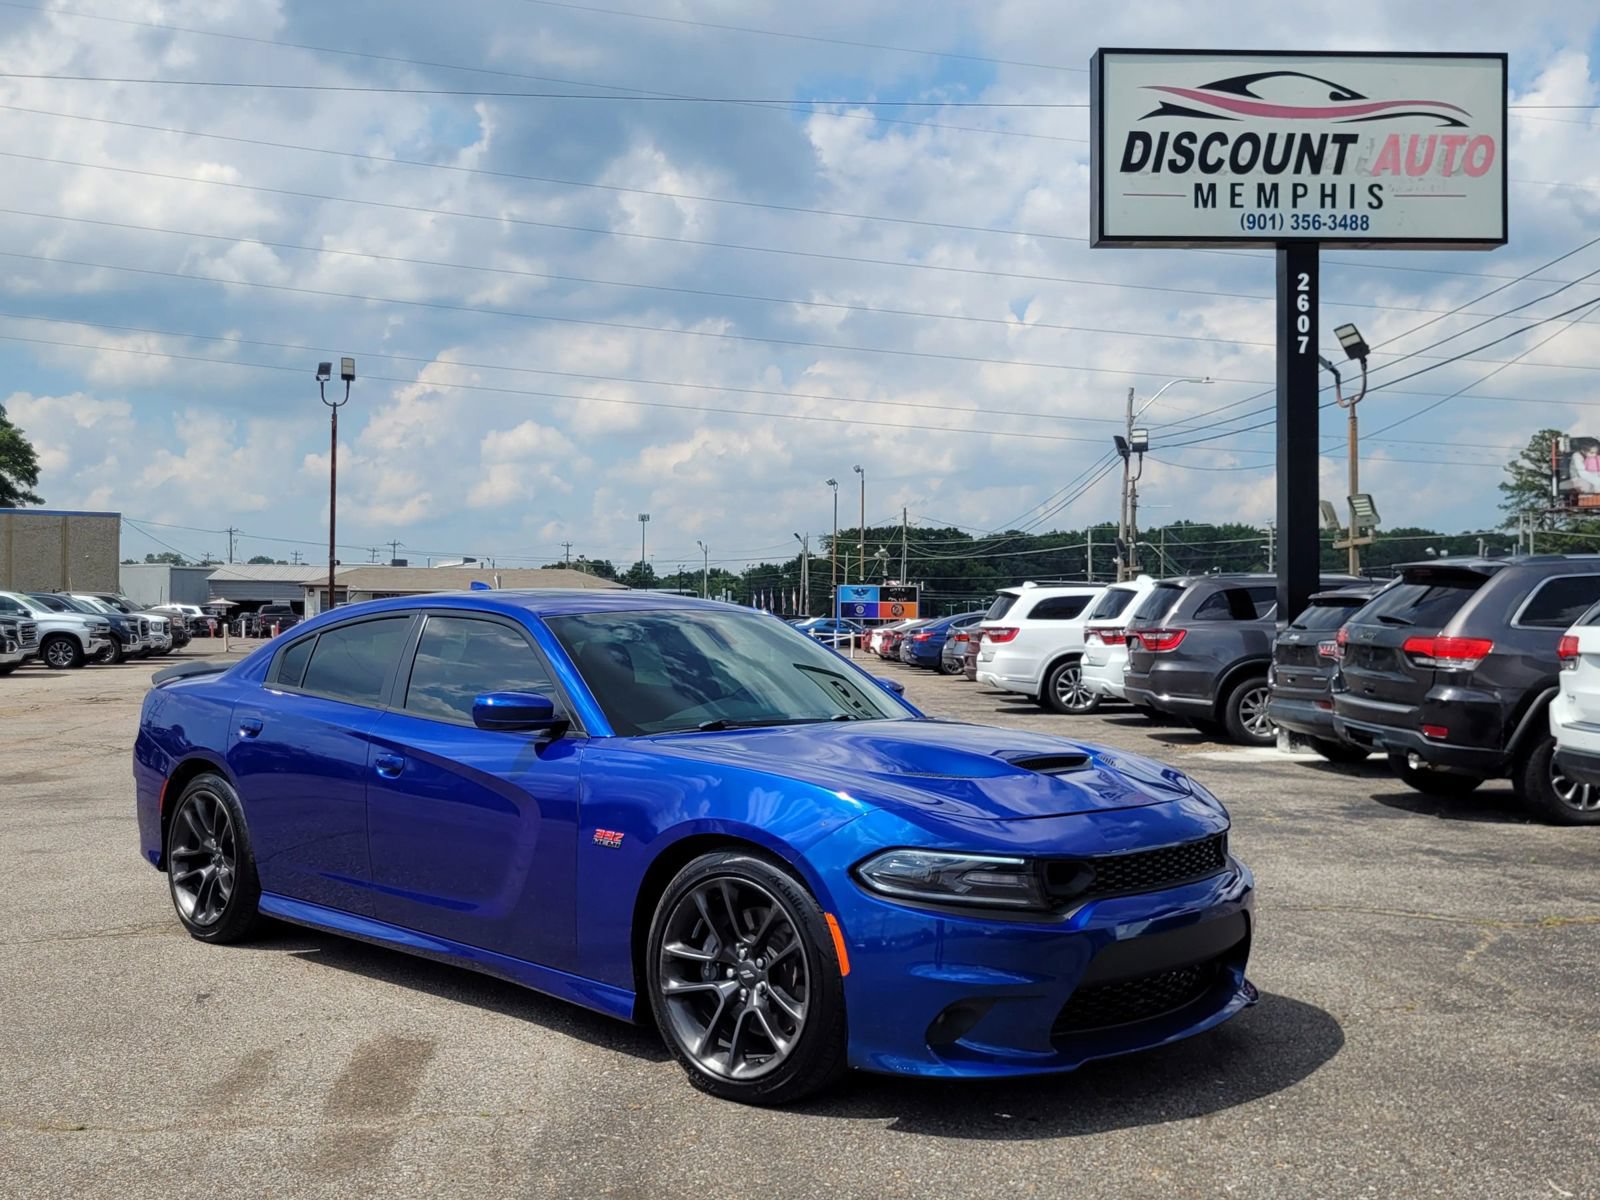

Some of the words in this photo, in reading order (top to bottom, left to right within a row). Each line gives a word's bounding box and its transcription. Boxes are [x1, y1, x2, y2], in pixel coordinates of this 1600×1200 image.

[1120, 130, 1359, 175] DISCOUNT
[1371, 133, 1495, 177] AUTO
[1193, 182, 1384, 210] MEMPHIS
[1240, 213, 1284, 232] (901)
[1290, 213, 1370, 232] 356-3488
[1297, 273, 1310, 354] 2607
